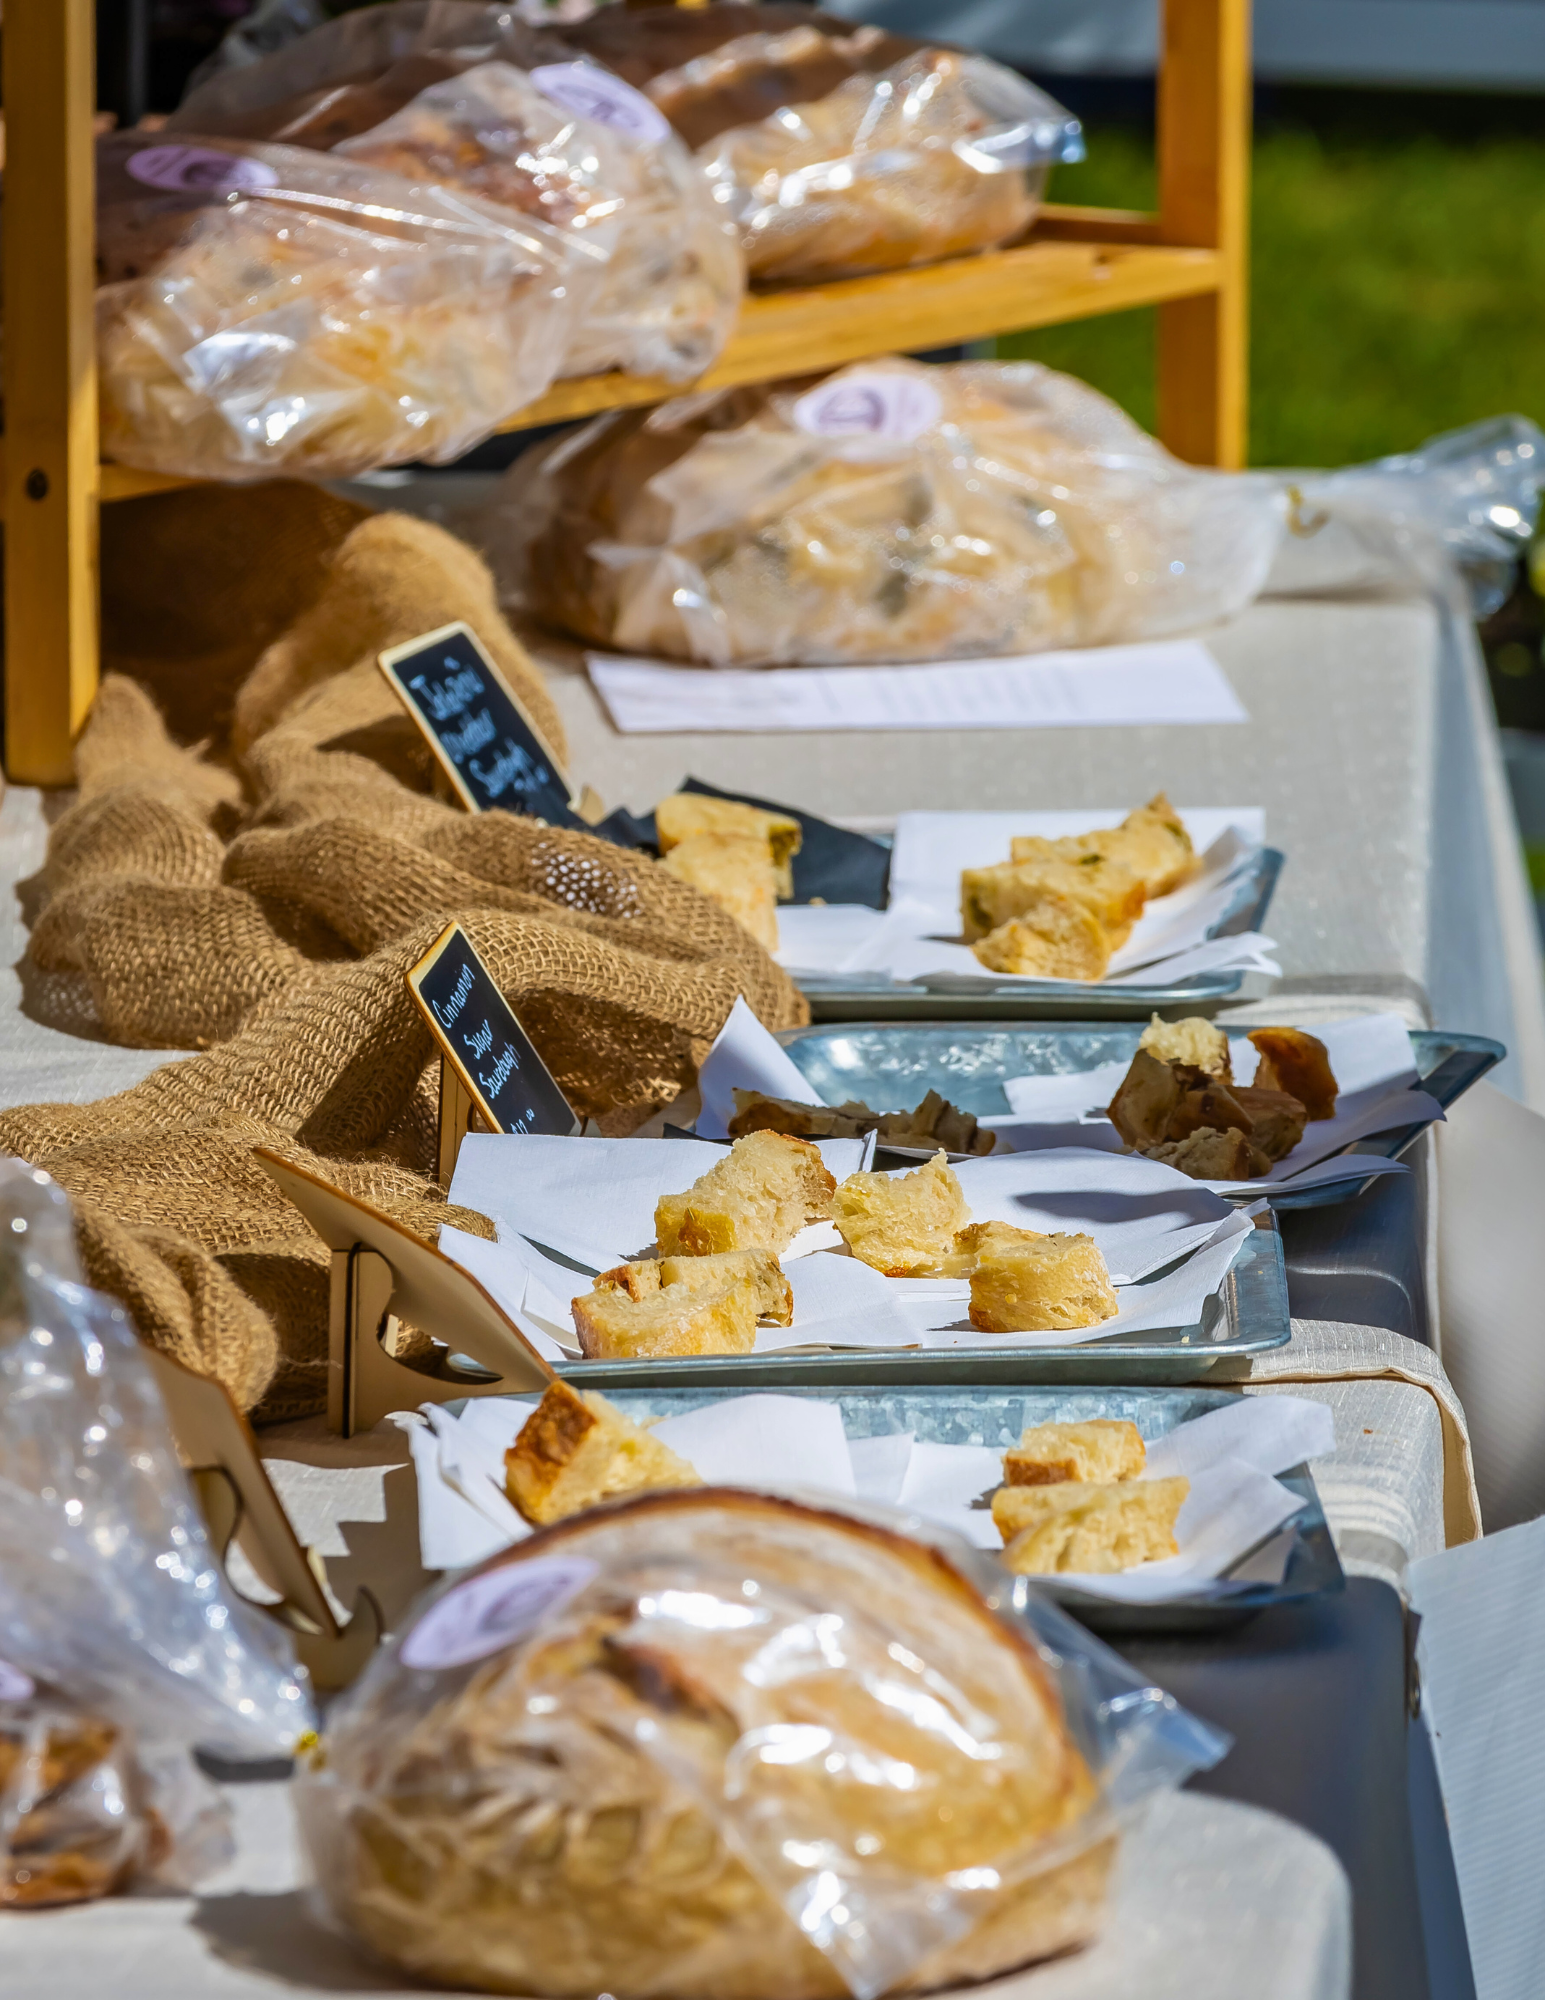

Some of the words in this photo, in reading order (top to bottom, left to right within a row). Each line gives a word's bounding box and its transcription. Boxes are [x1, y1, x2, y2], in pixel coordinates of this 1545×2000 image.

[432, 963, 475, 1029] Cinnamon
[463, 1019, 494, 1060] Sugar
[479, 1042, 521, 1099] Sourdough
